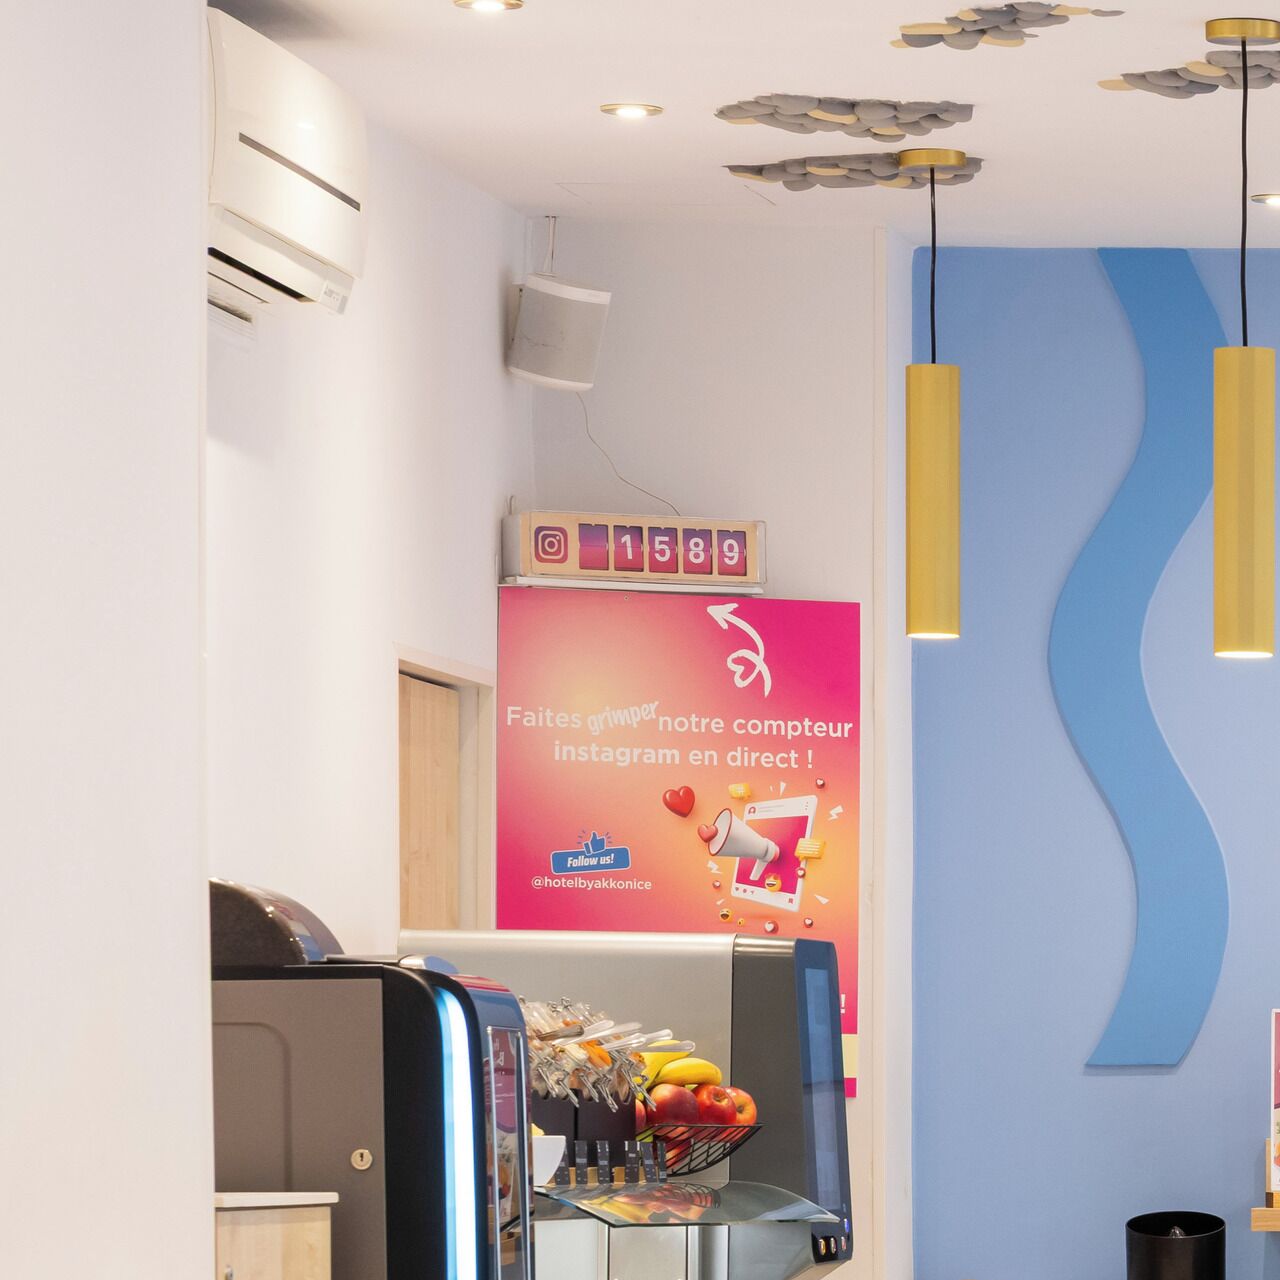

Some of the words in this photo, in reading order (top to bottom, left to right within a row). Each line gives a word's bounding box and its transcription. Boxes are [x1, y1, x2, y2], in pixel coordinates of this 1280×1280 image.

[506, 706, 582, 728] Faites
[587, 701, 659, 735] grimper
[658, 713, 725, 733] notre
[733, 718, 853, 740] compteur
[554, 740, 680, 767] instagram
[689, 749, 718, 766] en
[727, 746, 798, 769] direct
[567, 855, 598, 868] Follow
[600, 853, 615, 865] us!
[531, 875, 652, 890] @hotelbyakkonice
